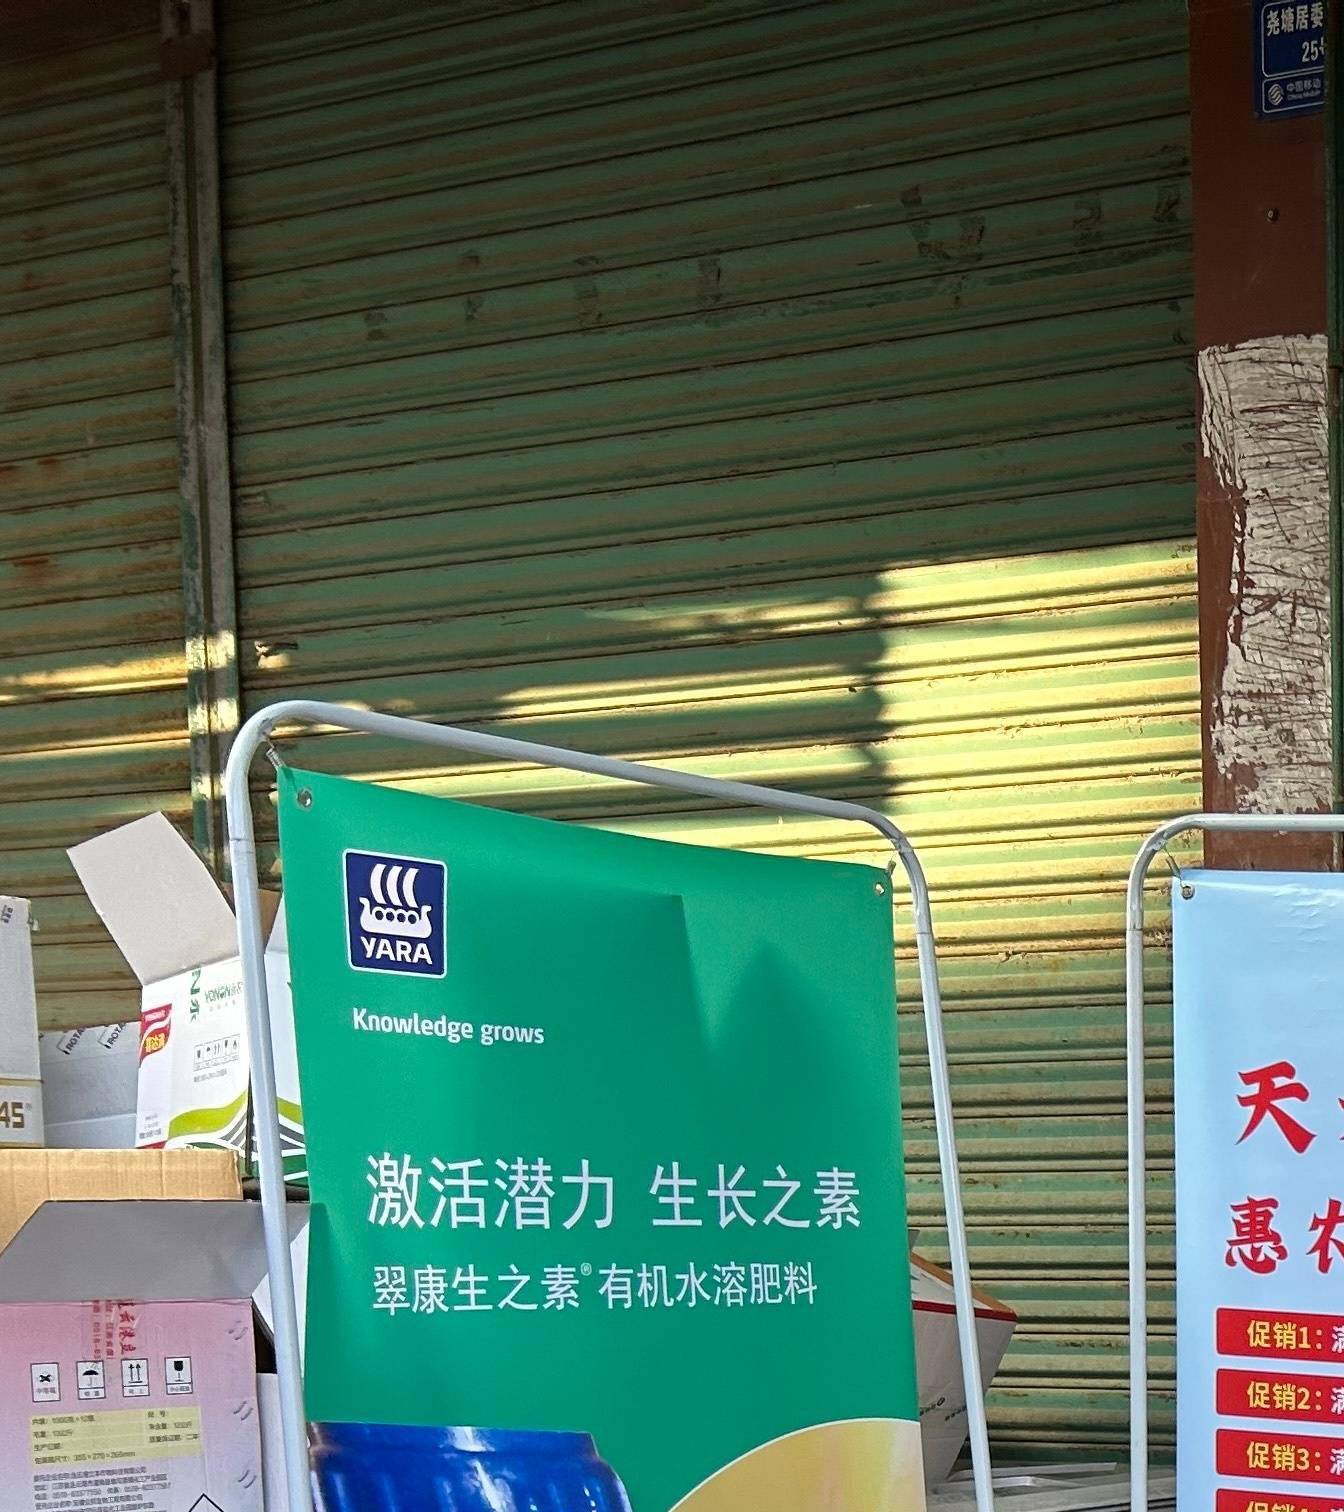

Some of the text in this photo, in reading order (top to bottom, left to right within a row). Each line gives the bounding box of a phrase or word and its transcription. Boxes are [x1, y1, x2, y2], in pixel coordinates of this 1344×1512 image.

[360, 938, 433, 966] YARA
[353, 1008, 545, 1047] Knowledge grows
[366, 1153, 862, 1232] 激活潜力 生长之素
